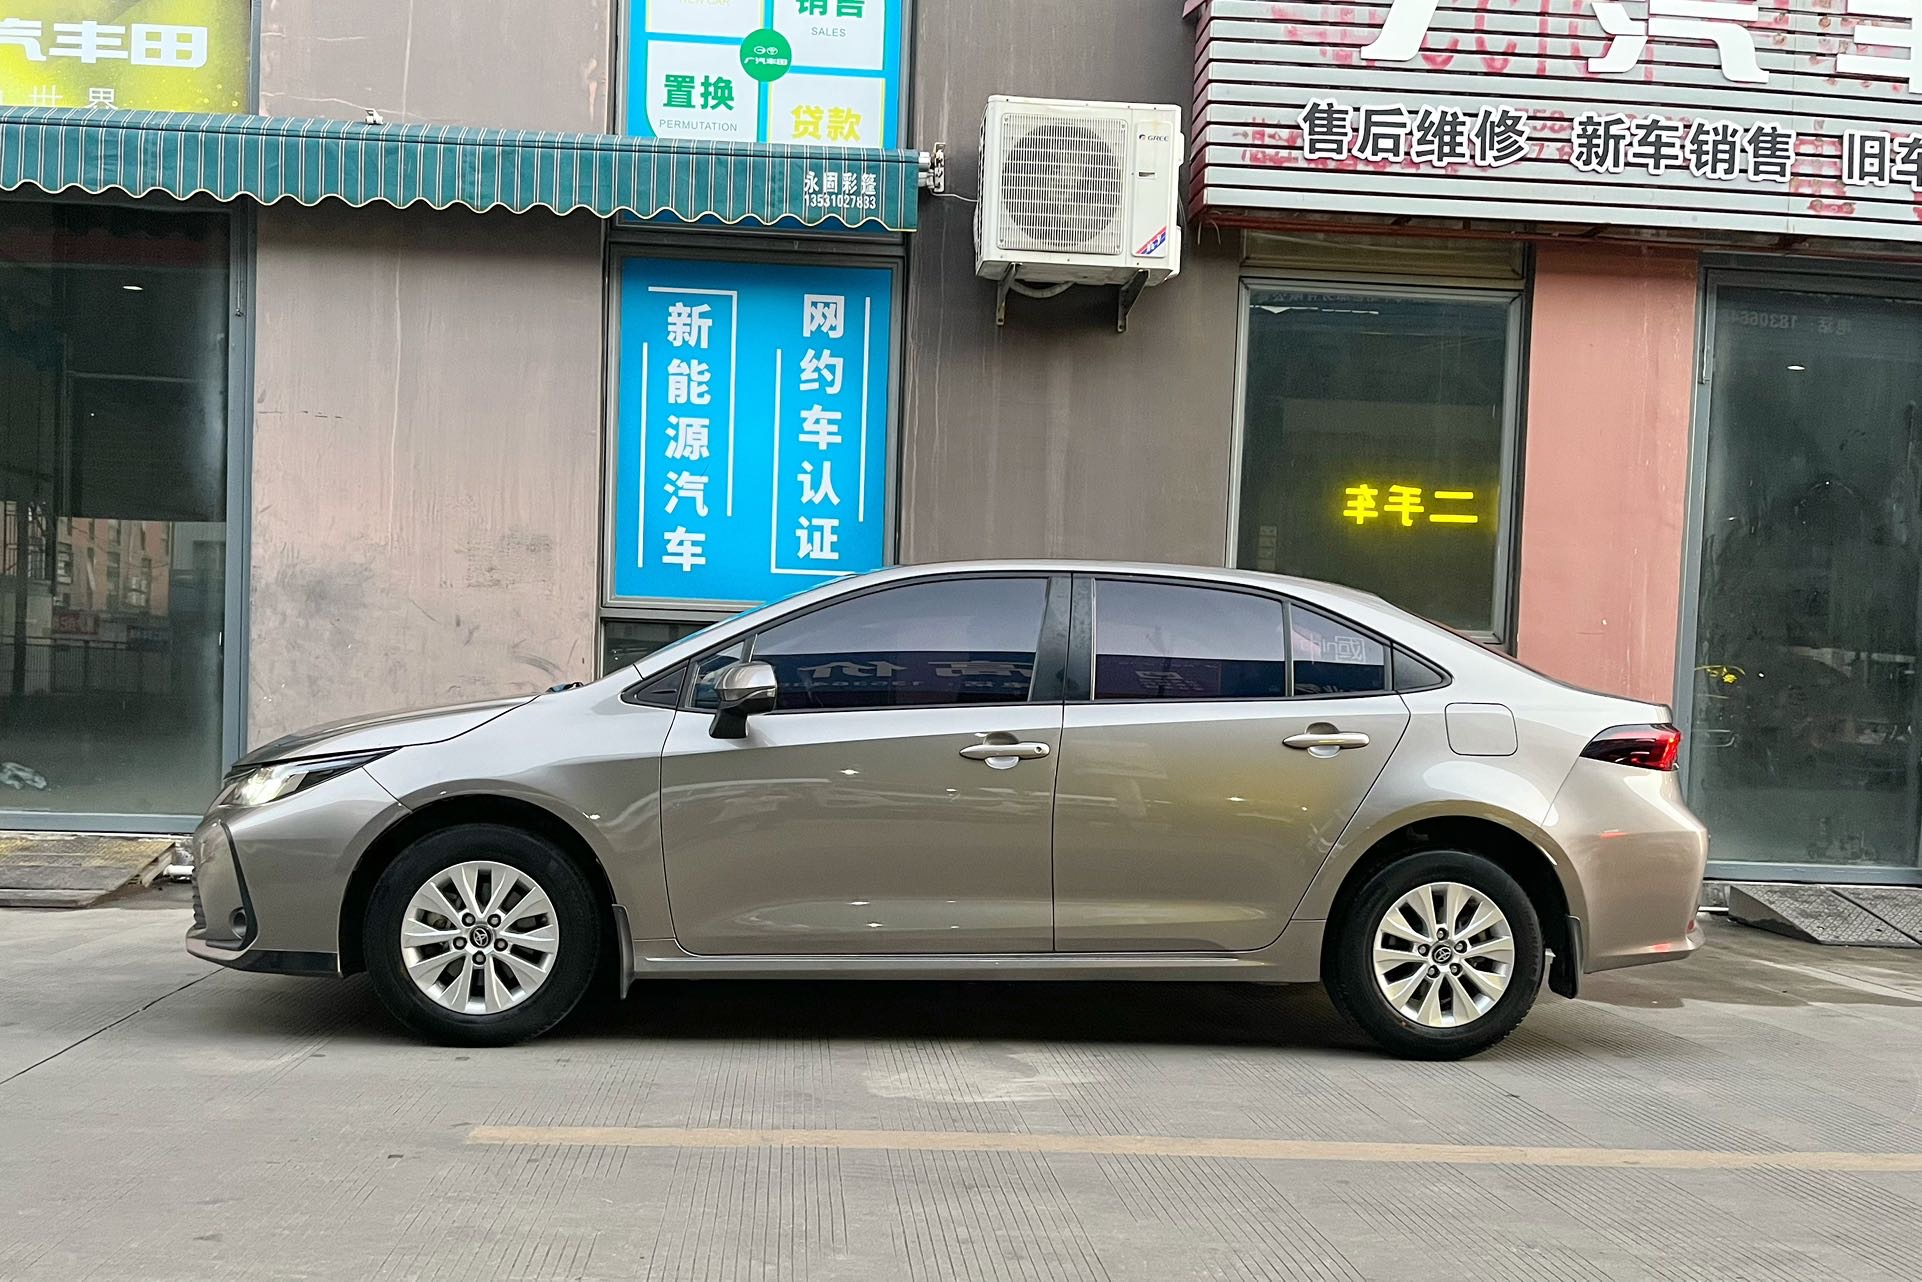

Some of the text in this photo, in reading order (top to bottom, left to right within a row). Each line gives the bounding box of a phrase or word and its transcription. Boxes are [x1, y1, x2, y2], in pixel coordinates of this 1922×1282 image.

[811, 26, 846, 37] SALES
[662, 74, 735, 111] 置换
[658, 119, 738, 132] PERMUTATION
[790, 104, 862, 142] 贷款
[1301, 101, 1529, 164] 售后维修
[1574, 115, 1794, 179] 新车销售
[662, 302, 713, 572] 新能源汽车
[795, 294, 845, 561] 网约车认证
